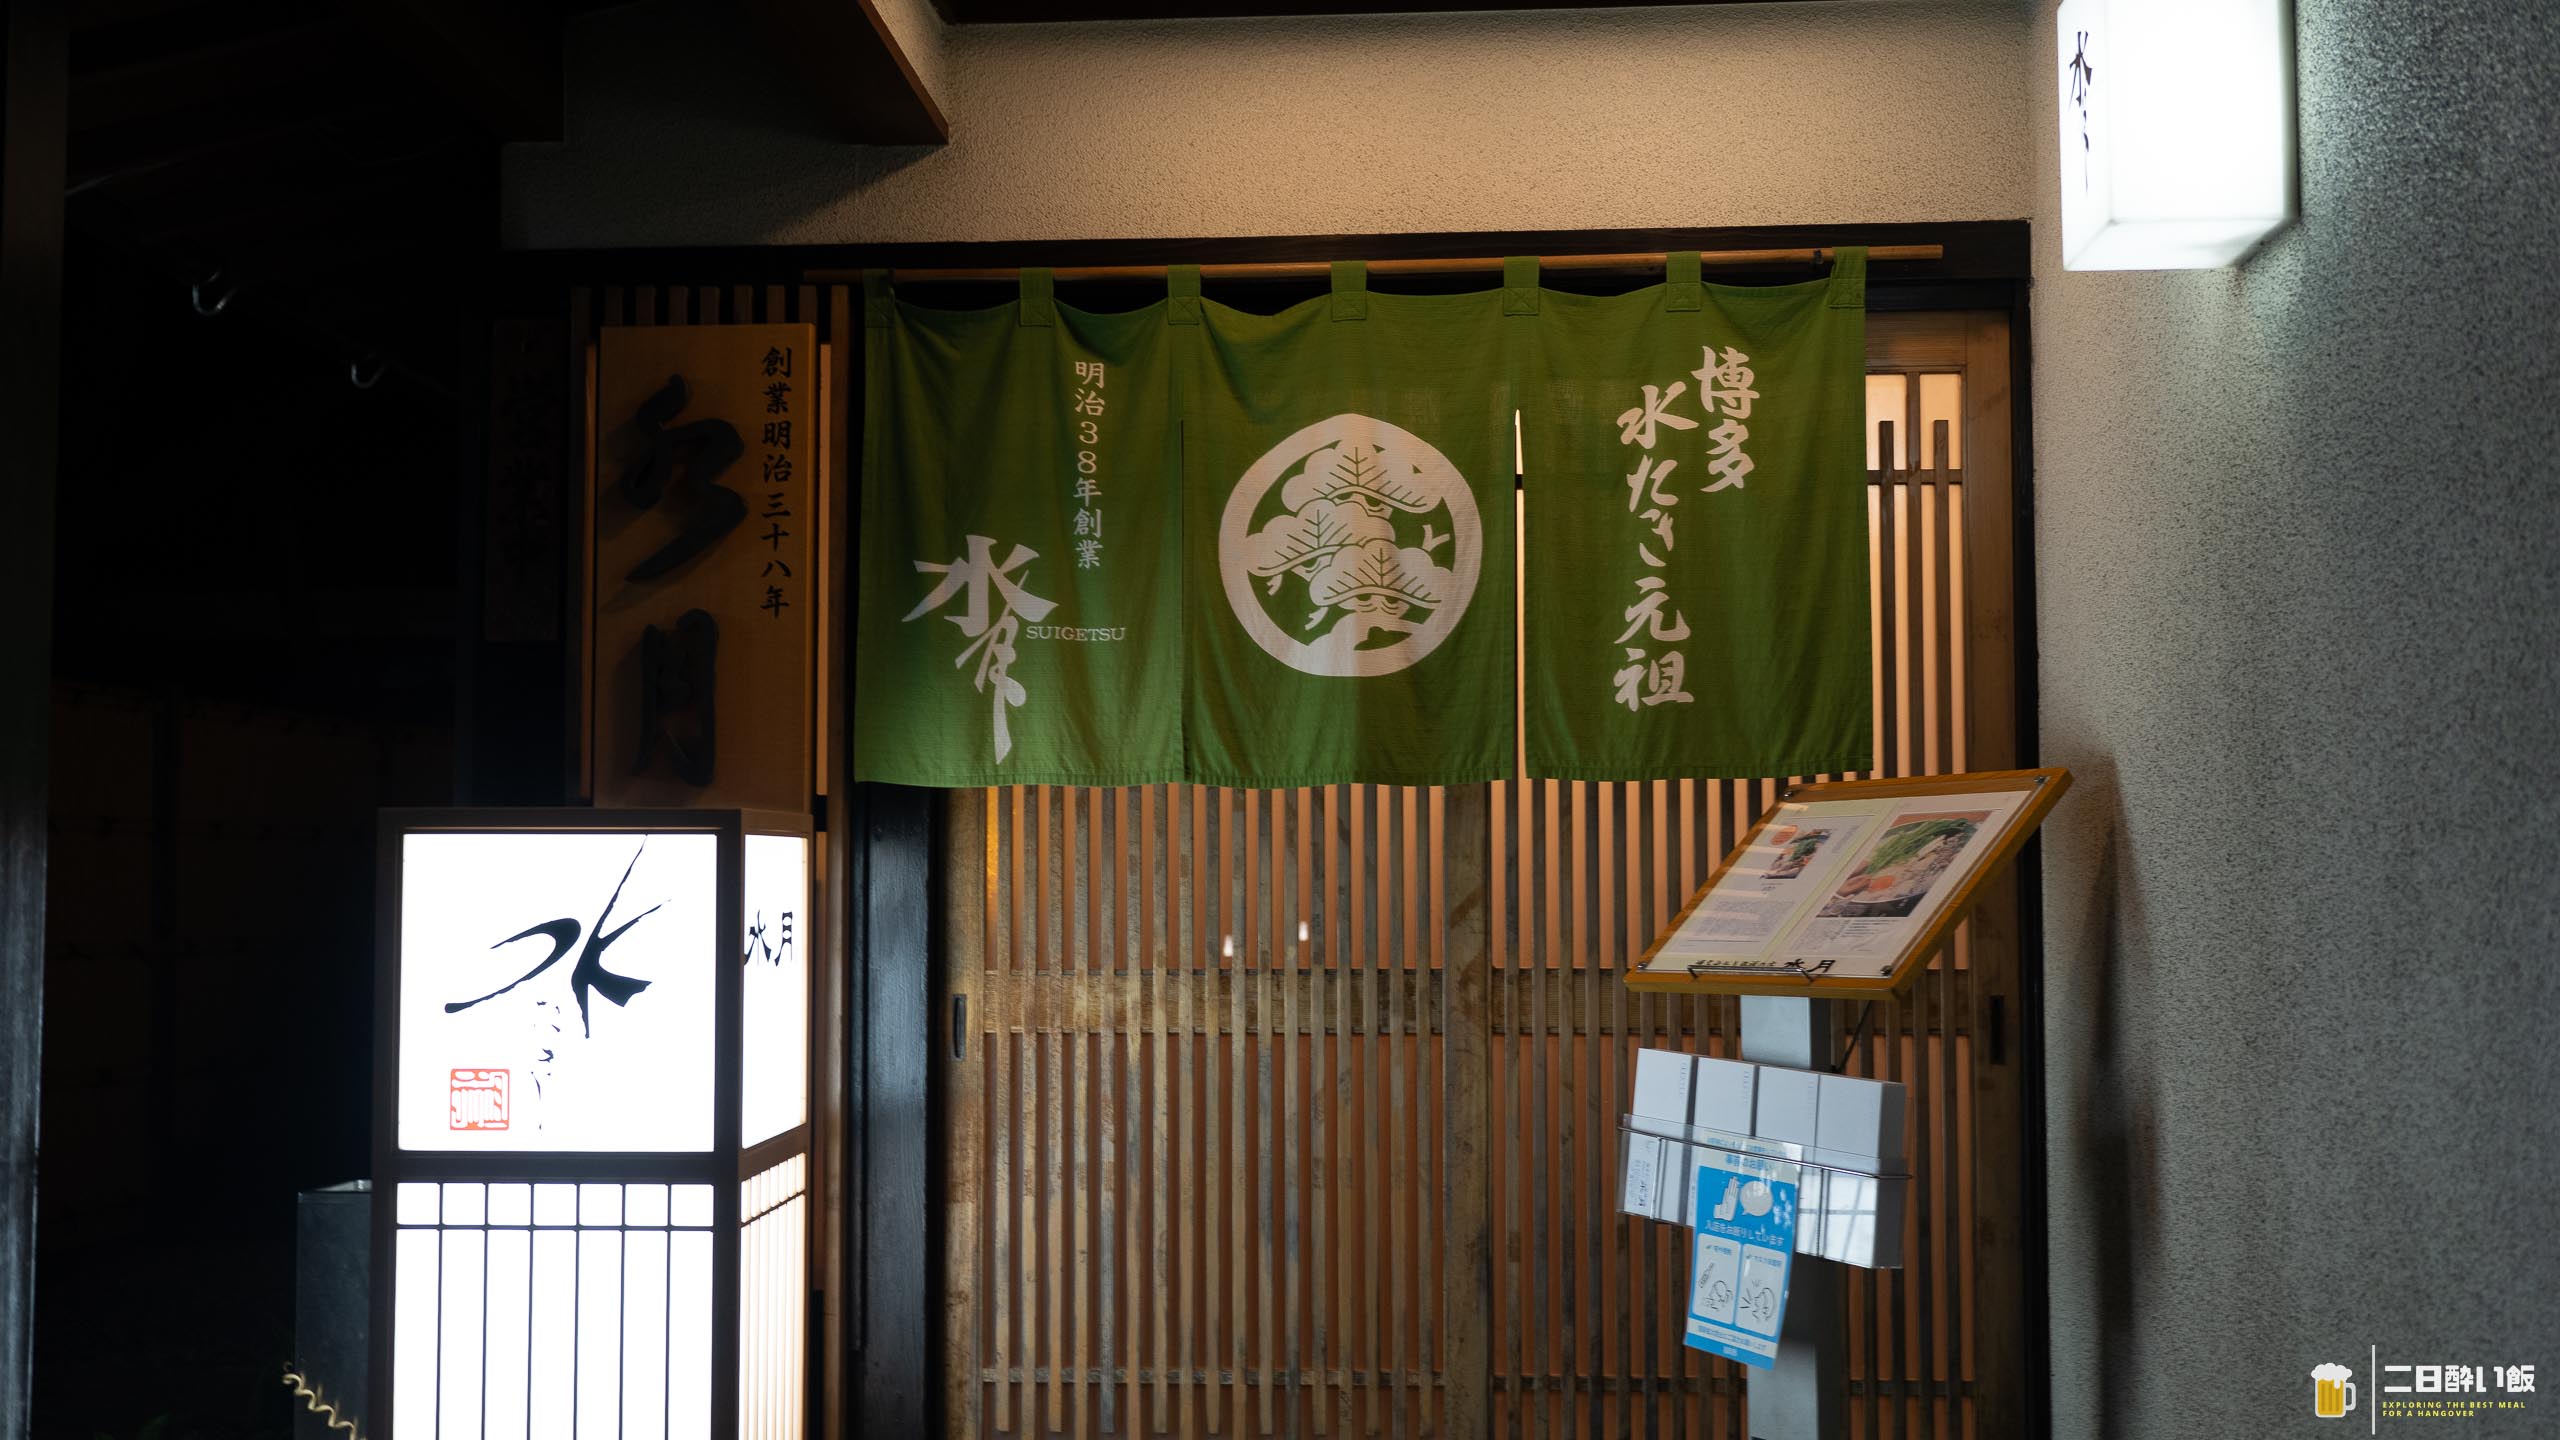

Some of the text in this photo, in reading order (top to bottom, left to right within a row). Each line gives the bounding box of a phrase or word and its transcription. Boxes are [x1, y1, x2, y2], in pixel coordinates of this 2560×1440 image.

[761, 346, 793, 619] 創業明治三十八年
[1073, 360, 1106, 569] 明治38年創業
[1690, 345, 1760, 493] 博多
[1026, 626, 1126, 642] SUIGETSU
[1613, 381, 1699, 712] 水たき元祖
[743, 909, 793, 967] 水月
